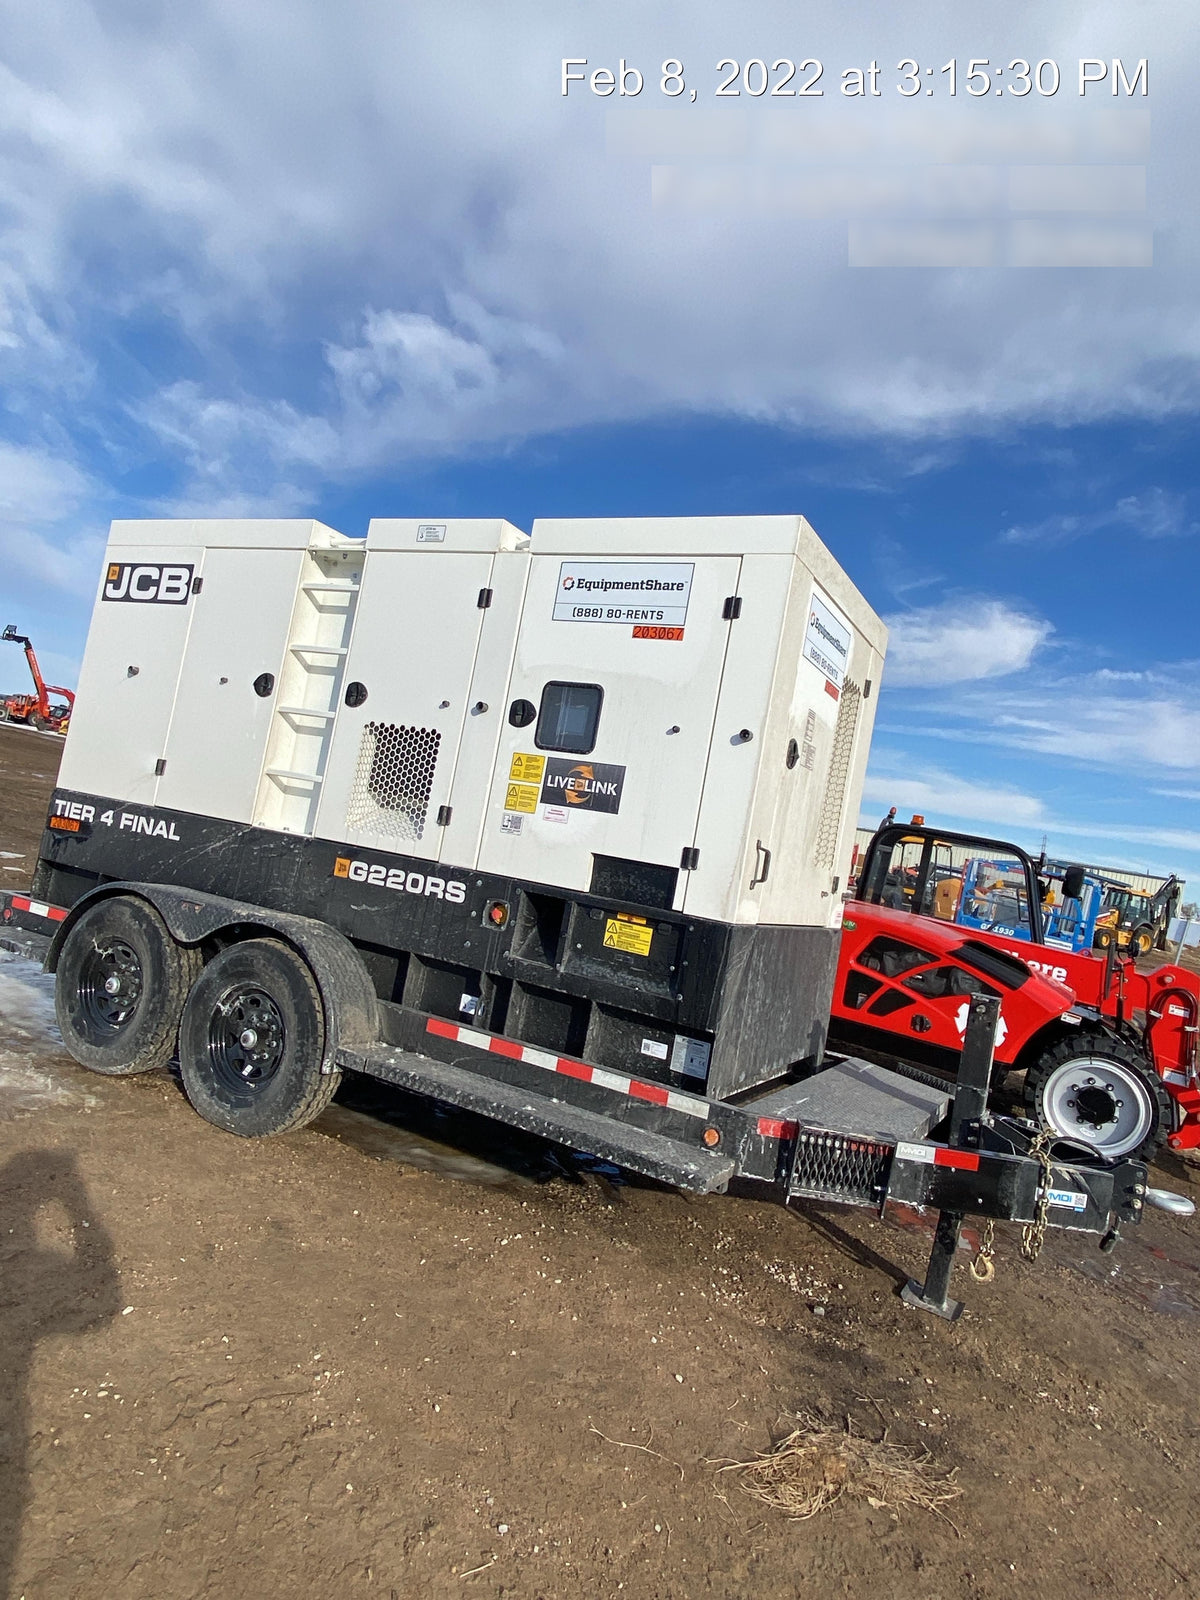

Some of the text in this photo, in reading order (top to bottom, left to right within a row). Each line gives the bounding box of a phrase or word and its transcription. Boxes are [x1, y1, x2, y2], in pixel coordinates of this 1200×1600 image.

[105, 566, 190, 601] JCB
[576, 578, 685, 592] EquipmentShare
[572, 606, 665, 621] (888) 80-RENTS
[633, 626, 685, 640] 203067
[547, 774, 618, 796] LIVE LINK
[55, 799, 181, 841] TIER 4 FINAL
[348, 860, 467, 904] G220RS
